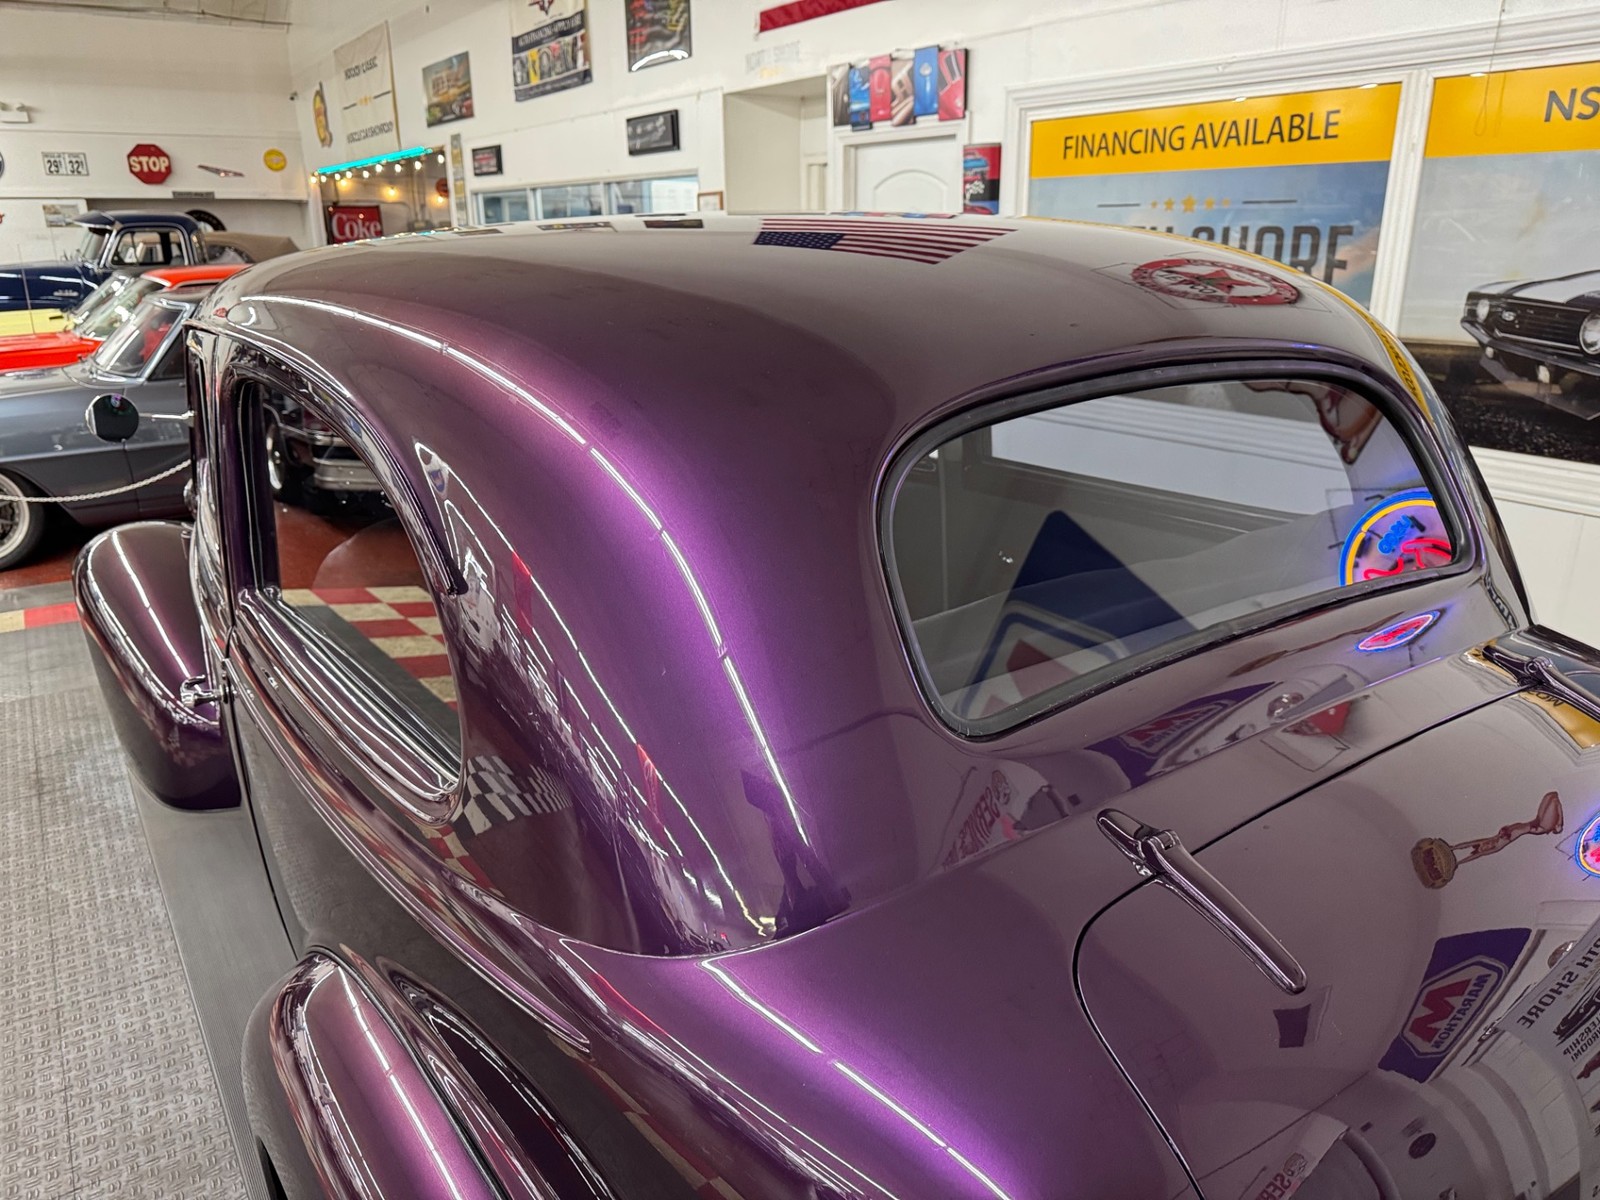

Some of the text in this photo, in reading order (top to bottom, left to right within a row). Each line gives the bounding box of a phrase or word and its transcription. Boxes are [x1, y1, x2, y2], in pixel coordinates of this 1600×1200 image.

[1544, 86, 1600, 122] NS
[1062, 109, 1341, 160] FINANCING AVAILABLE
[129, 155, 170, 173] STOP
[331, 212, 381, 240] Coke
